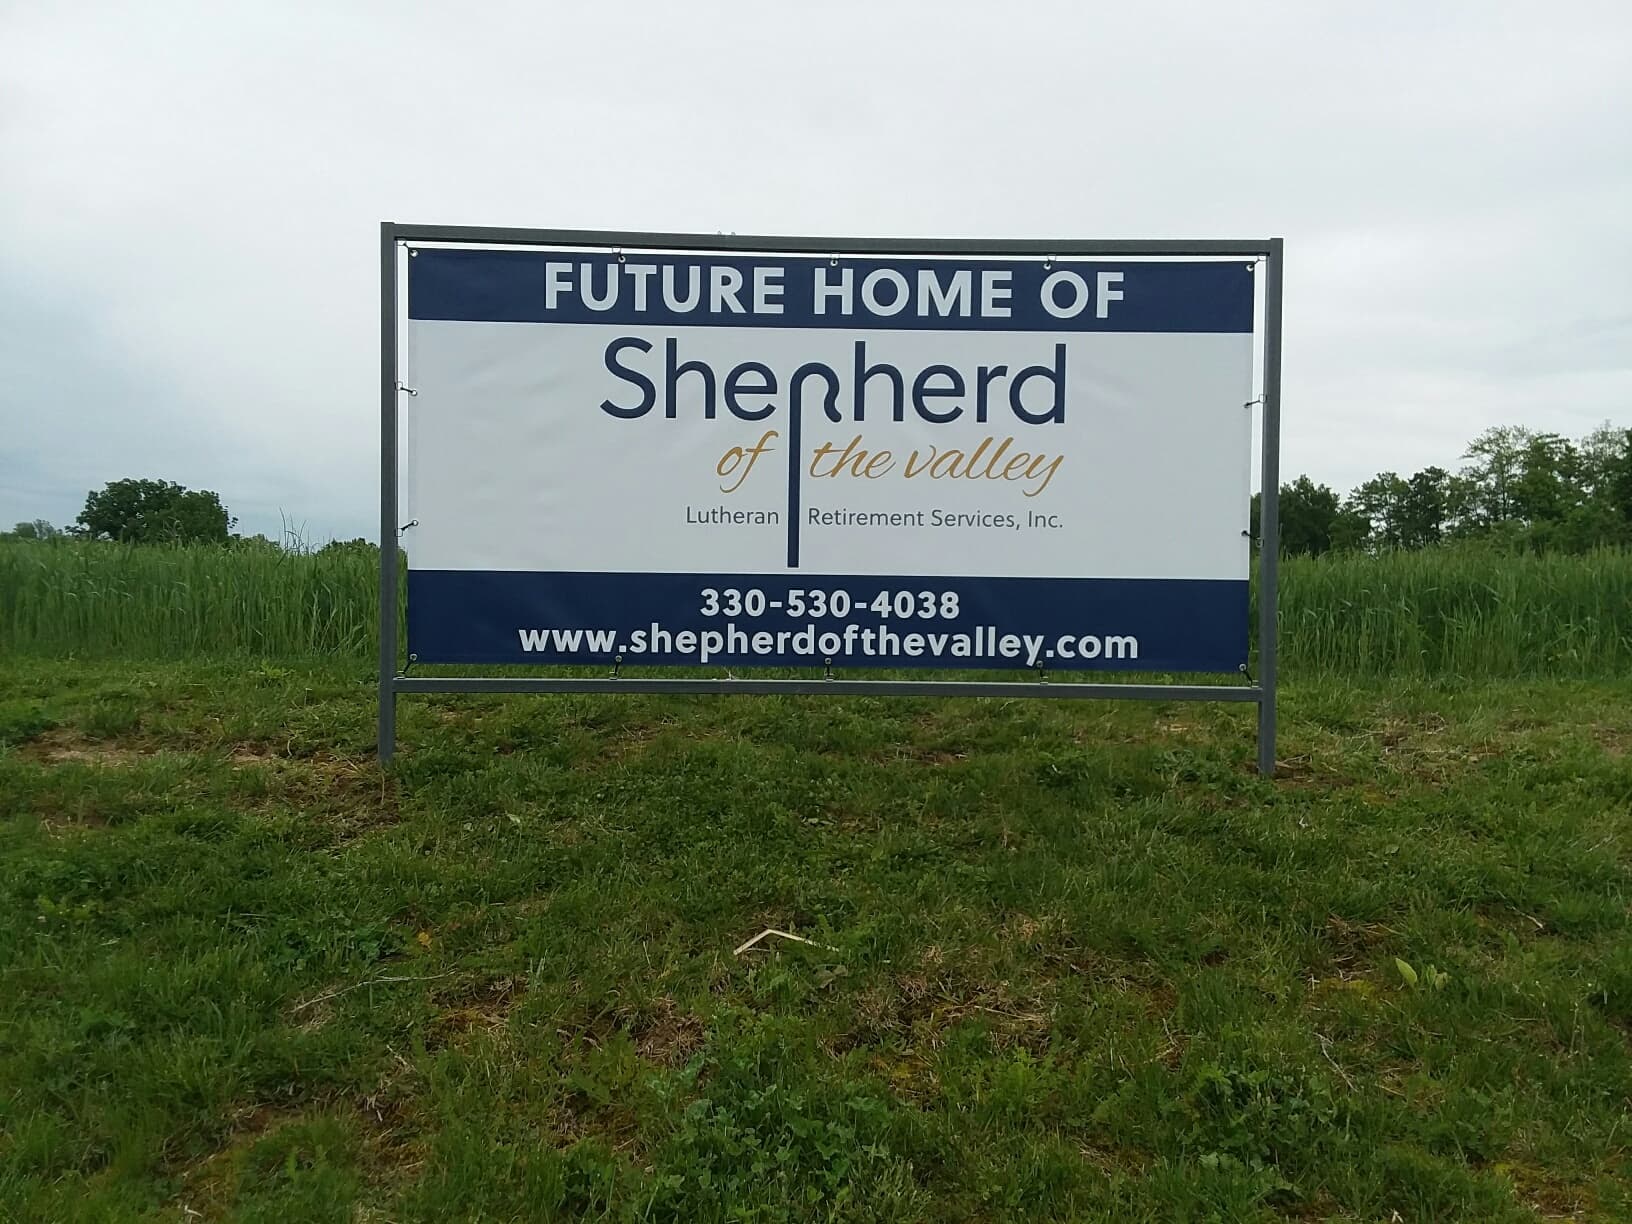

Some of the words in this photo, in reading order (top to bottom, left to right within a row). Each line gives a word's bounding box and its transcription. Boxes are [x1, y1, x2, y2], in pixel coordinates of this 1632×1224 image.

[544, 261, 786, 315] FUTURE
[812, 266, 1014, 319] HOME
[1040, 270, 1126, 320] OF
[716, 430, 779, 494] of
[809, 434, 897, 479] the
[903, 436, 1065, 497] valley
[686, 506, 779, 525] Lutheran
[808, 508, 925, 527] Retirement
[931, 510, 1021, 531] Services,
[1028, 511, 1063, 529] Inc.
[700, 588, 960, 619] 330-530-4038
[518, 623, 1139, 667] www.shepherdofthevalley.com
